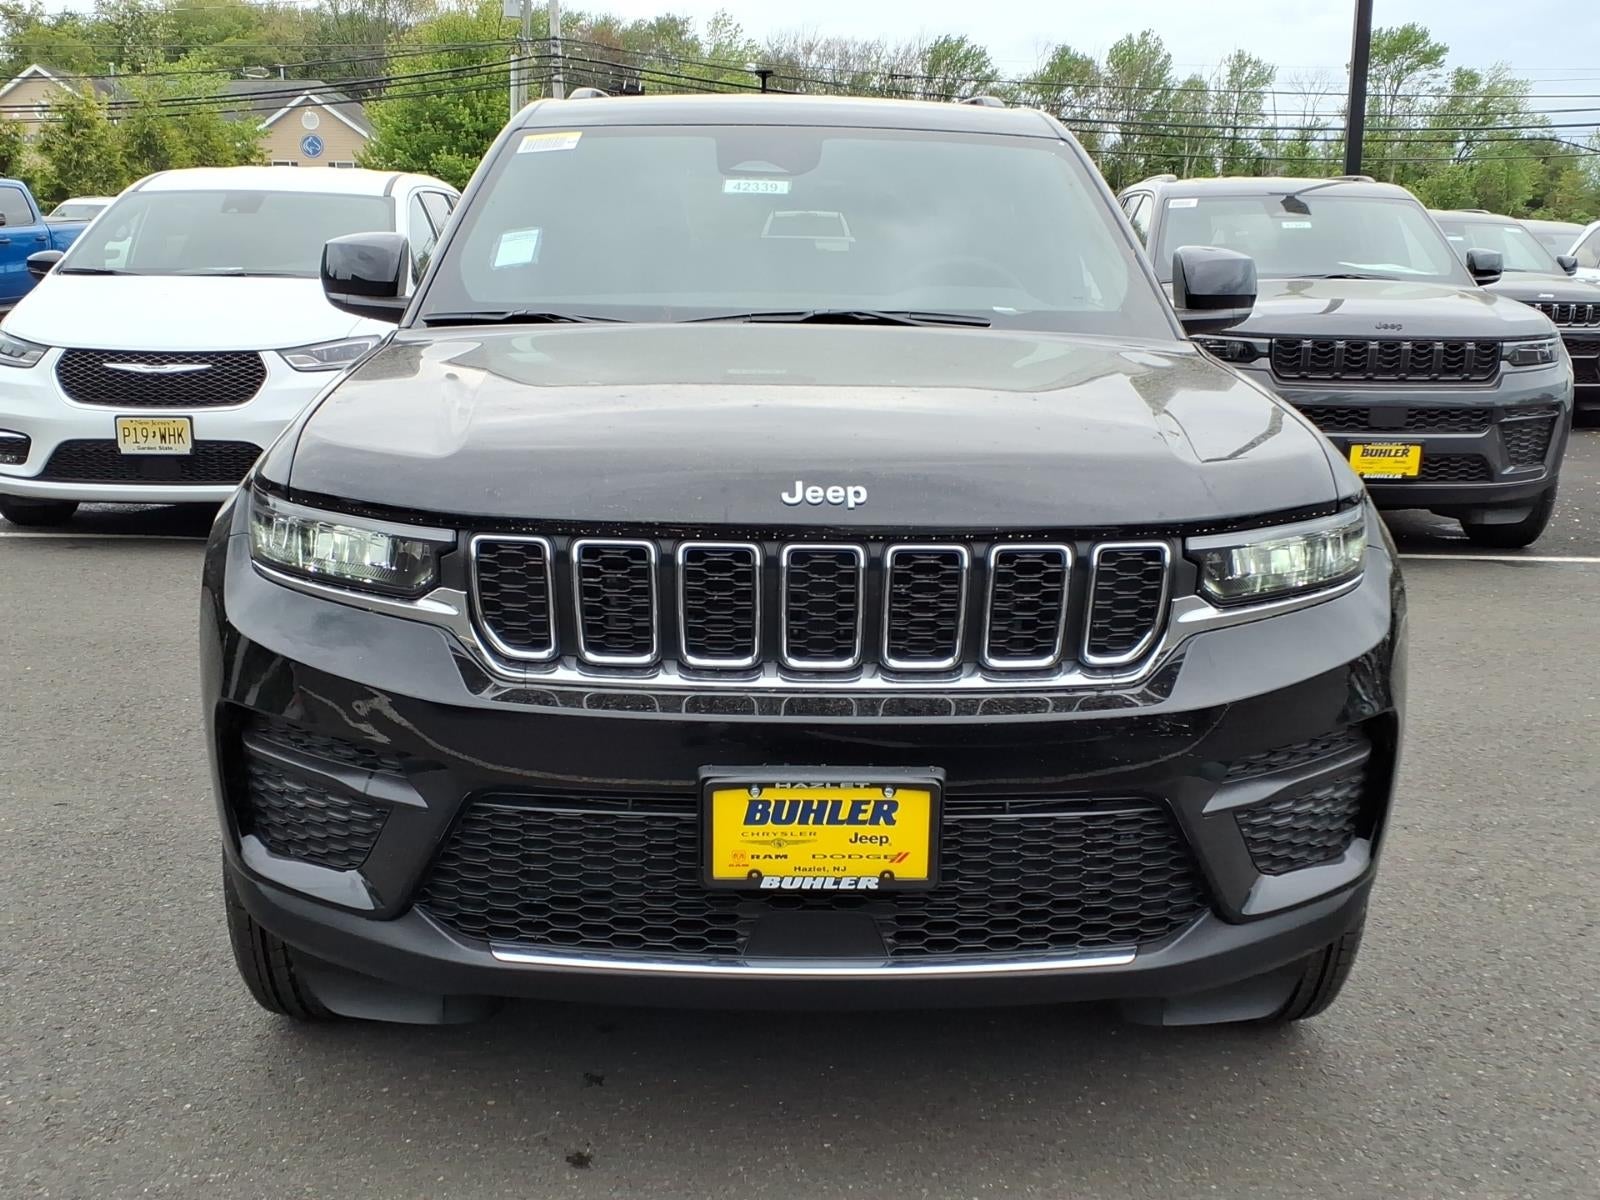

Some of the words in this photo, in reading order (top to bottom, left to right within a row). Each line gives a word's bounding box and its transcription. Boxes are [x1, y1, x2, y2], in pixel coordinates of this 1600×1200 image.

[732, 182, 778, 192] 42339
[1375, 322, 1403, 331] Jeep
[1360, 448, 1410, 458] BUHLER
[781, 480, 868, 510] Jeep
[743, 799, 899, 826] BUHLER
[849, 832, 890, 847] Jeep
[759, 876, 880, 890] BUHLER
